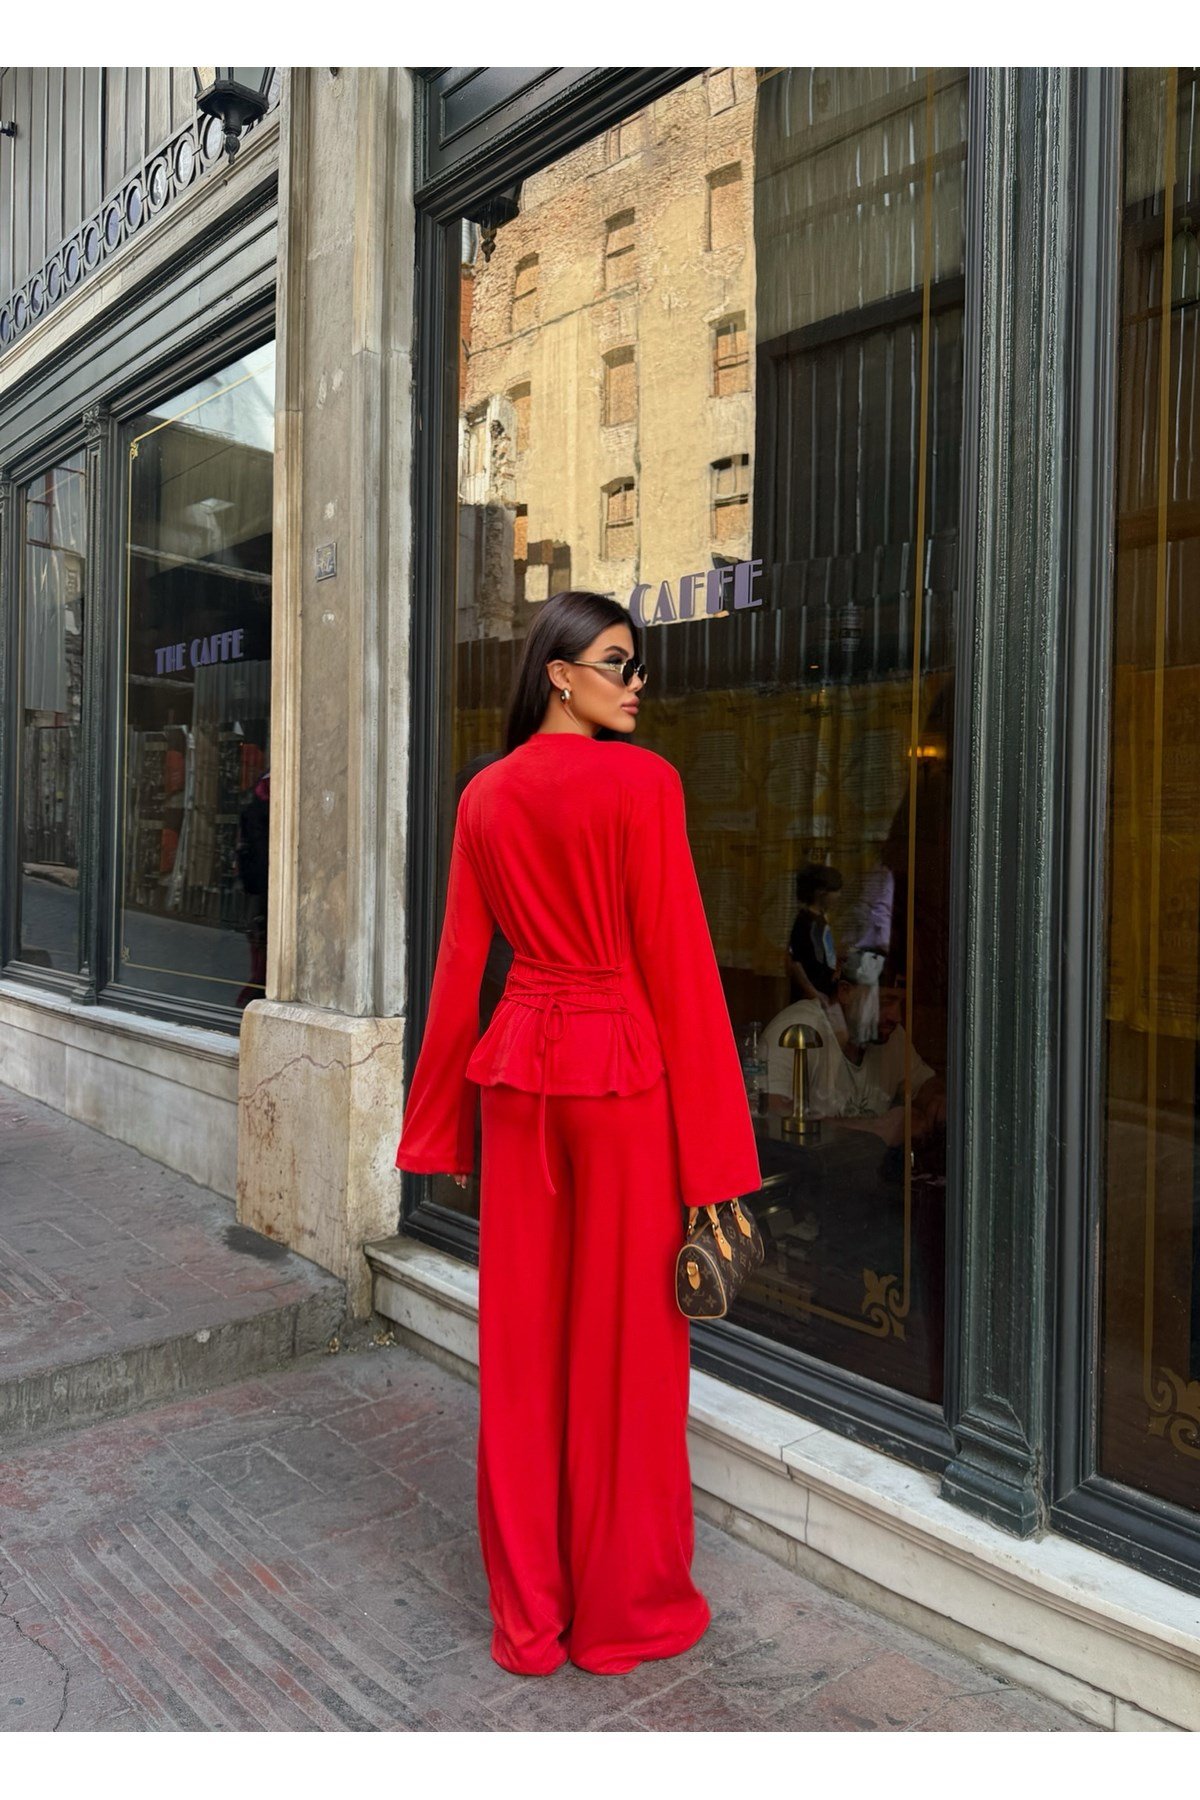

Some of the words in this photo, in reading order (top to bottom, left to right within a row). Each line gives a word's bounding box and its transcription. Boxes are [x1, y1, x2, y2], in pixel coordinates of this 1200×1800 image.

[629, 559, 763, 628] CAFFE
[154, 642, 187, 675] THE
[190, 628, 244, 668] CAFFE
